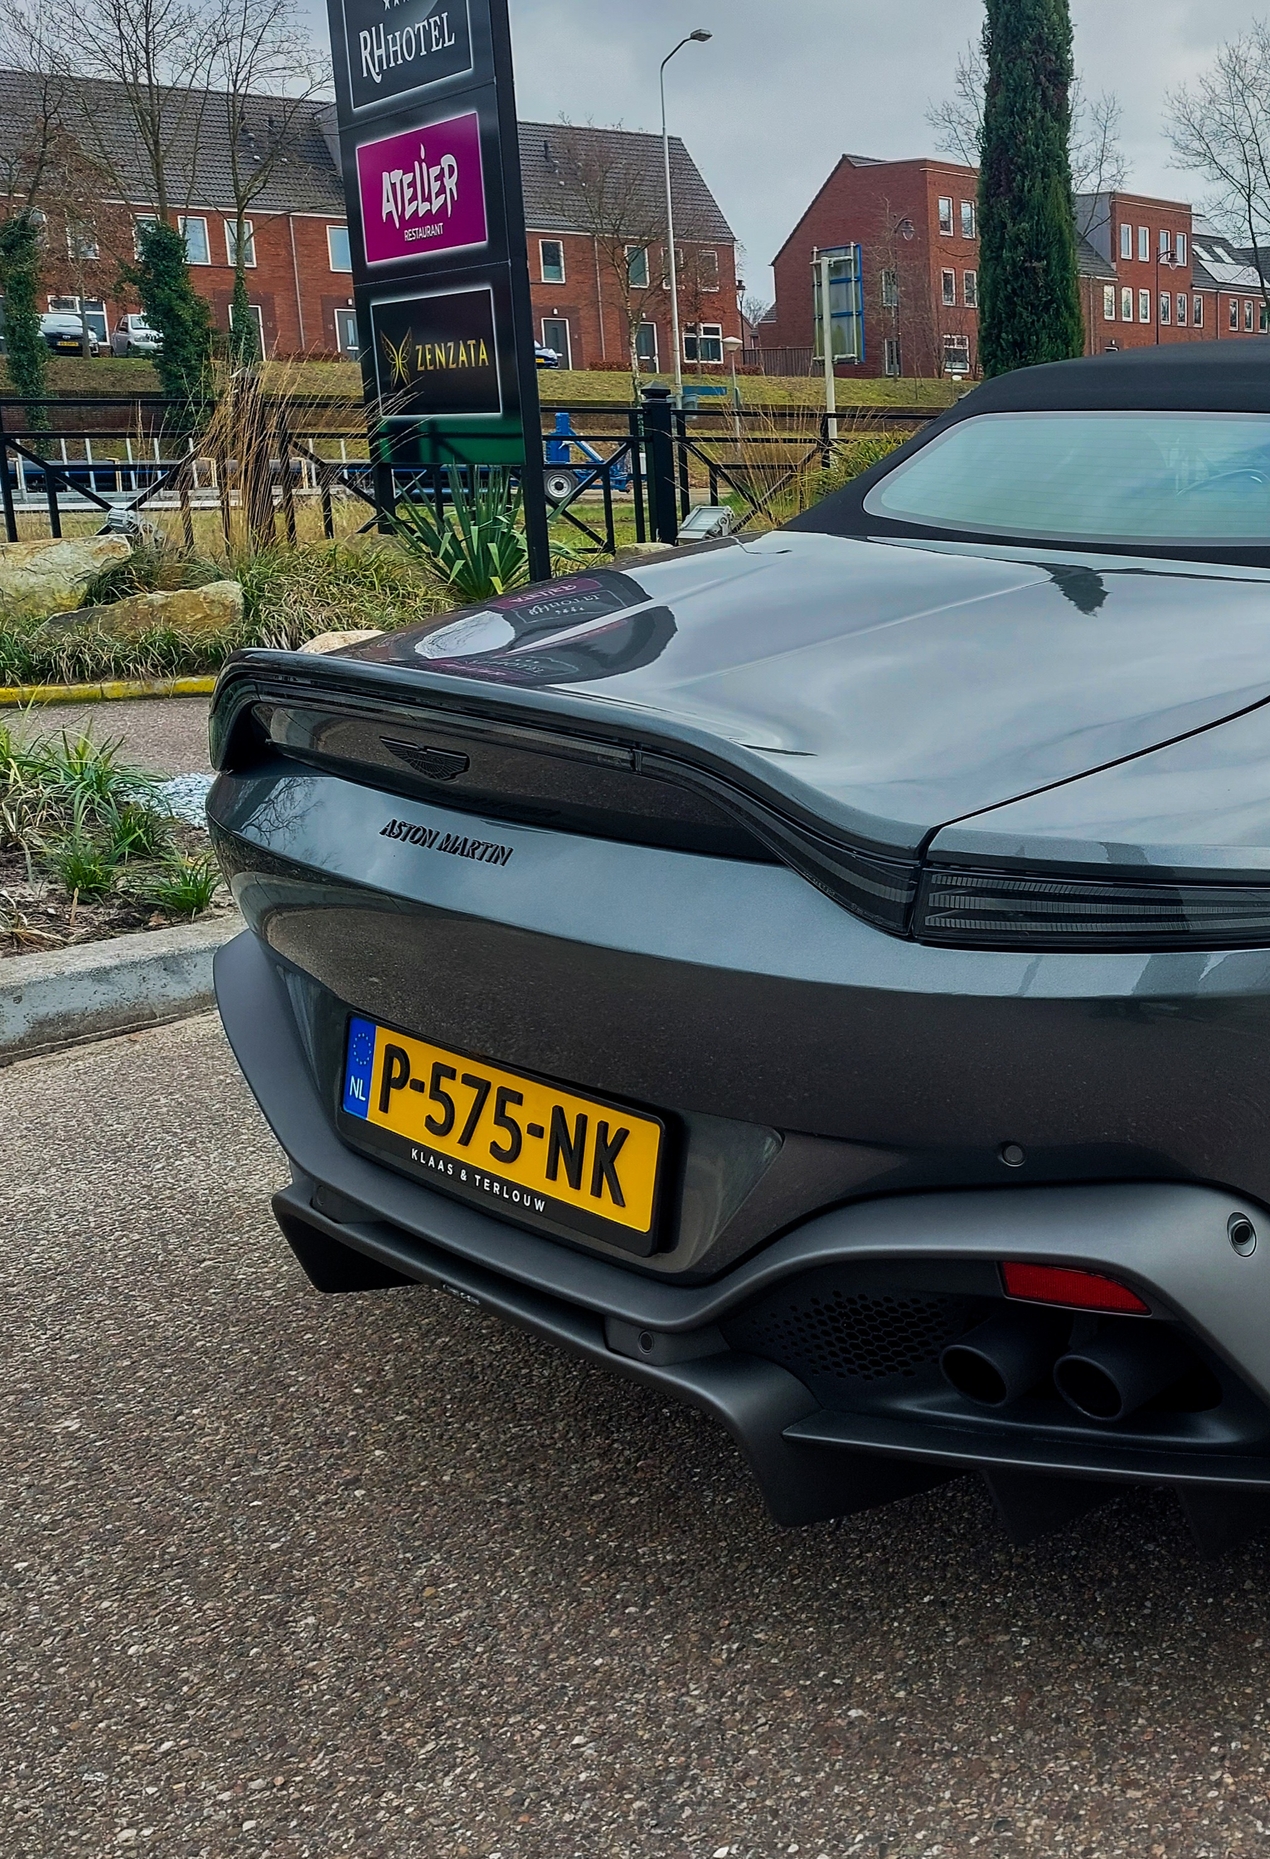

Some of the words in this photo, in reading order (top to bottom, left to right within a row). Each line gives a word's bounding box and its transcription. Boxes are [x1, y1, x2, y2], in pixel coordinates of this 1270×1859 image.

[403, 222, 444, 242] RESTAURANT
[415, 338, 490, 372] ZENZATA
[378, 818, 441, 850] ASTON
[435, 832, 515, 867] MARTIN
[349, 1075, 366, 1102] NL
[378, 1042, 631, 1209] P-575-NK
[411, 1148, 454, 1176] KLAAS
[459, 1168, 468, 1182] &
[474, 1173, 546, 1213] TERLOUW
